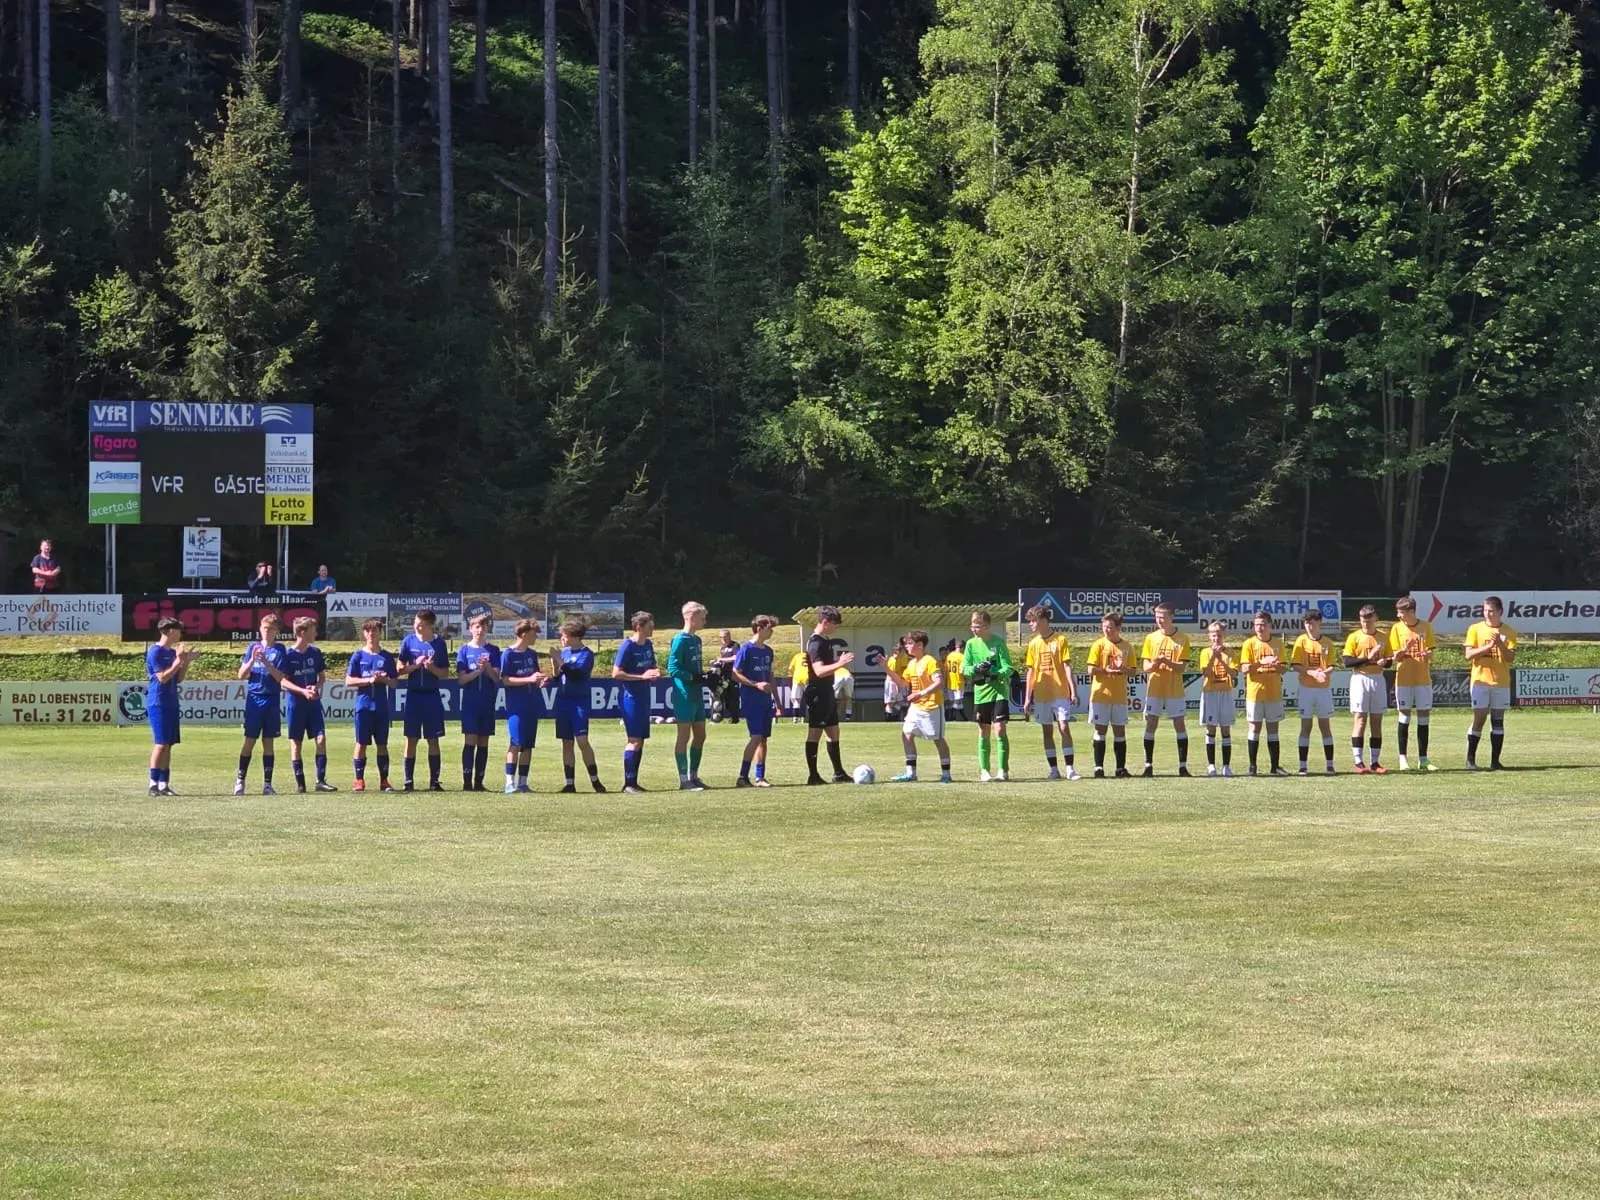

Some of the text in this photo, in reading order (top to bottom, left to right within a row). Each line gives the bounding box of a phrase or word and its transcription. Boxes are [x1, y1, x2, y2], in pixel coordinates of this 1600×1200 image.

[94, 406, 128, 421] VfR
[150, 402, 254, 427] SENNEKE
[94, 434, 137, 452] figaro
[267, 466, 311, 474] METALLBAU
[214, 474, 265, 494] GÄSTE
[267, 475, 311, 484] MEINEL
[91, 500, 139, 517] acerto.de
[272, 498, 305, 508] Lotto
[270, 511, 307, 522] Franz
[231, 595, 261, 604] Freude
[350, 598, 385, 608] MERCER
[390, 597, 438, 605] NACHHALTIG
[1069, 592, 1162, 602] LOBENSTEINER
[1069, 602, 1155, 616] Dachdeck
[1199, 599, 1310, 614] WOHLFARTH
[1447, 604, 1487, 618] raa
[18, 616, 91, 632] Petersilie
[1272, 619, 1304, 629] WAN
[232, 633, 252, 641] Bad
[947, 660, 958, 674] 16
[1519, 670, 1570, 682] Pizzeria-
[330, 684, 359, 700] Gm
[1519, 684, 1579, 696] Ristorante
[12, 693, 36, 704] BAD
[40, 693, 112, 704] LOBENSTEIN
[591, 687, 621, 709] BA
[1519, 698, 1534, 706] Bad
[1581, 698, 1600, 706] Wurz
[13, 708, 111, 722] Tel.: 31 206
[178, 706, 355, 719] oda-Partn Marx
